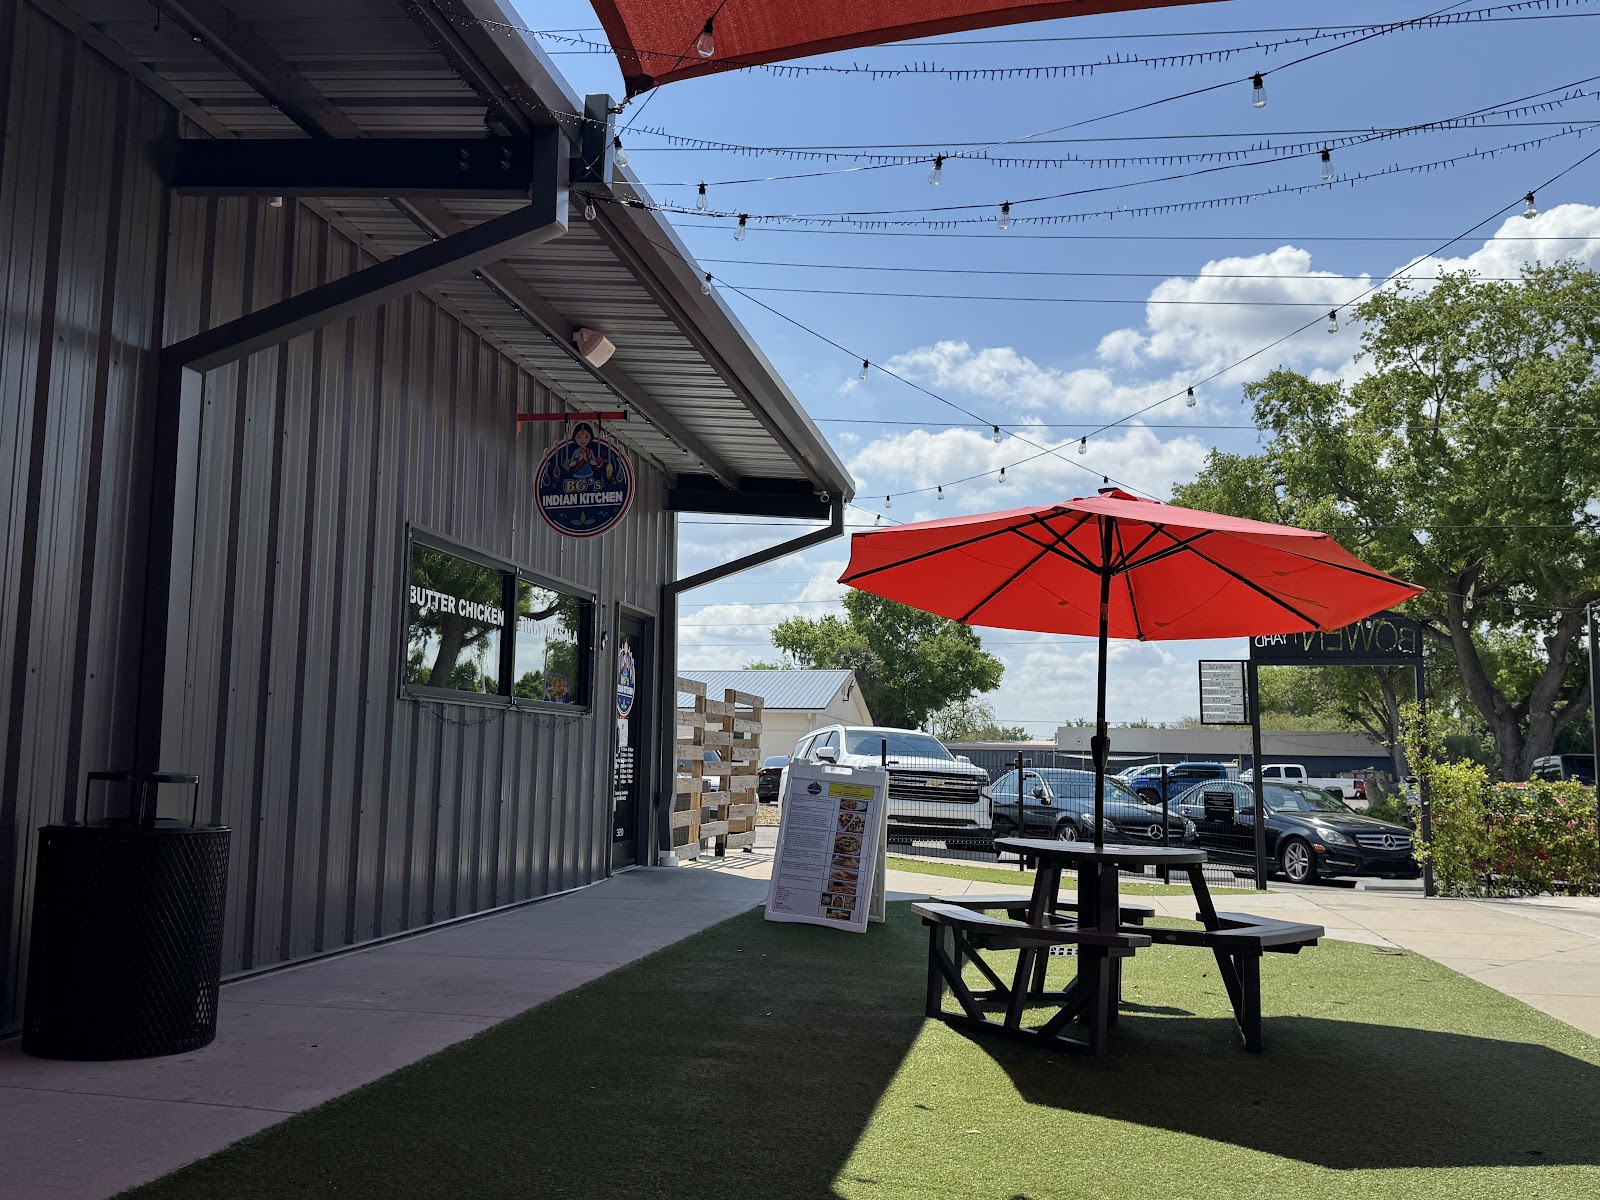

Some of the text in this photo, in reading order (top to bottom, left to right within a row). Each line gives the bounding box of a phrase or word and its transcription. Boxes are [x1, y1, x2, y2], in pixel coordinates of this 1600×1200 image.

[563, 477, 603, 493] BG's
[542, 491, 623, 507] INDIAN KITCHEN
[409, 585, 505, 626] BUTTER CHICKEN
